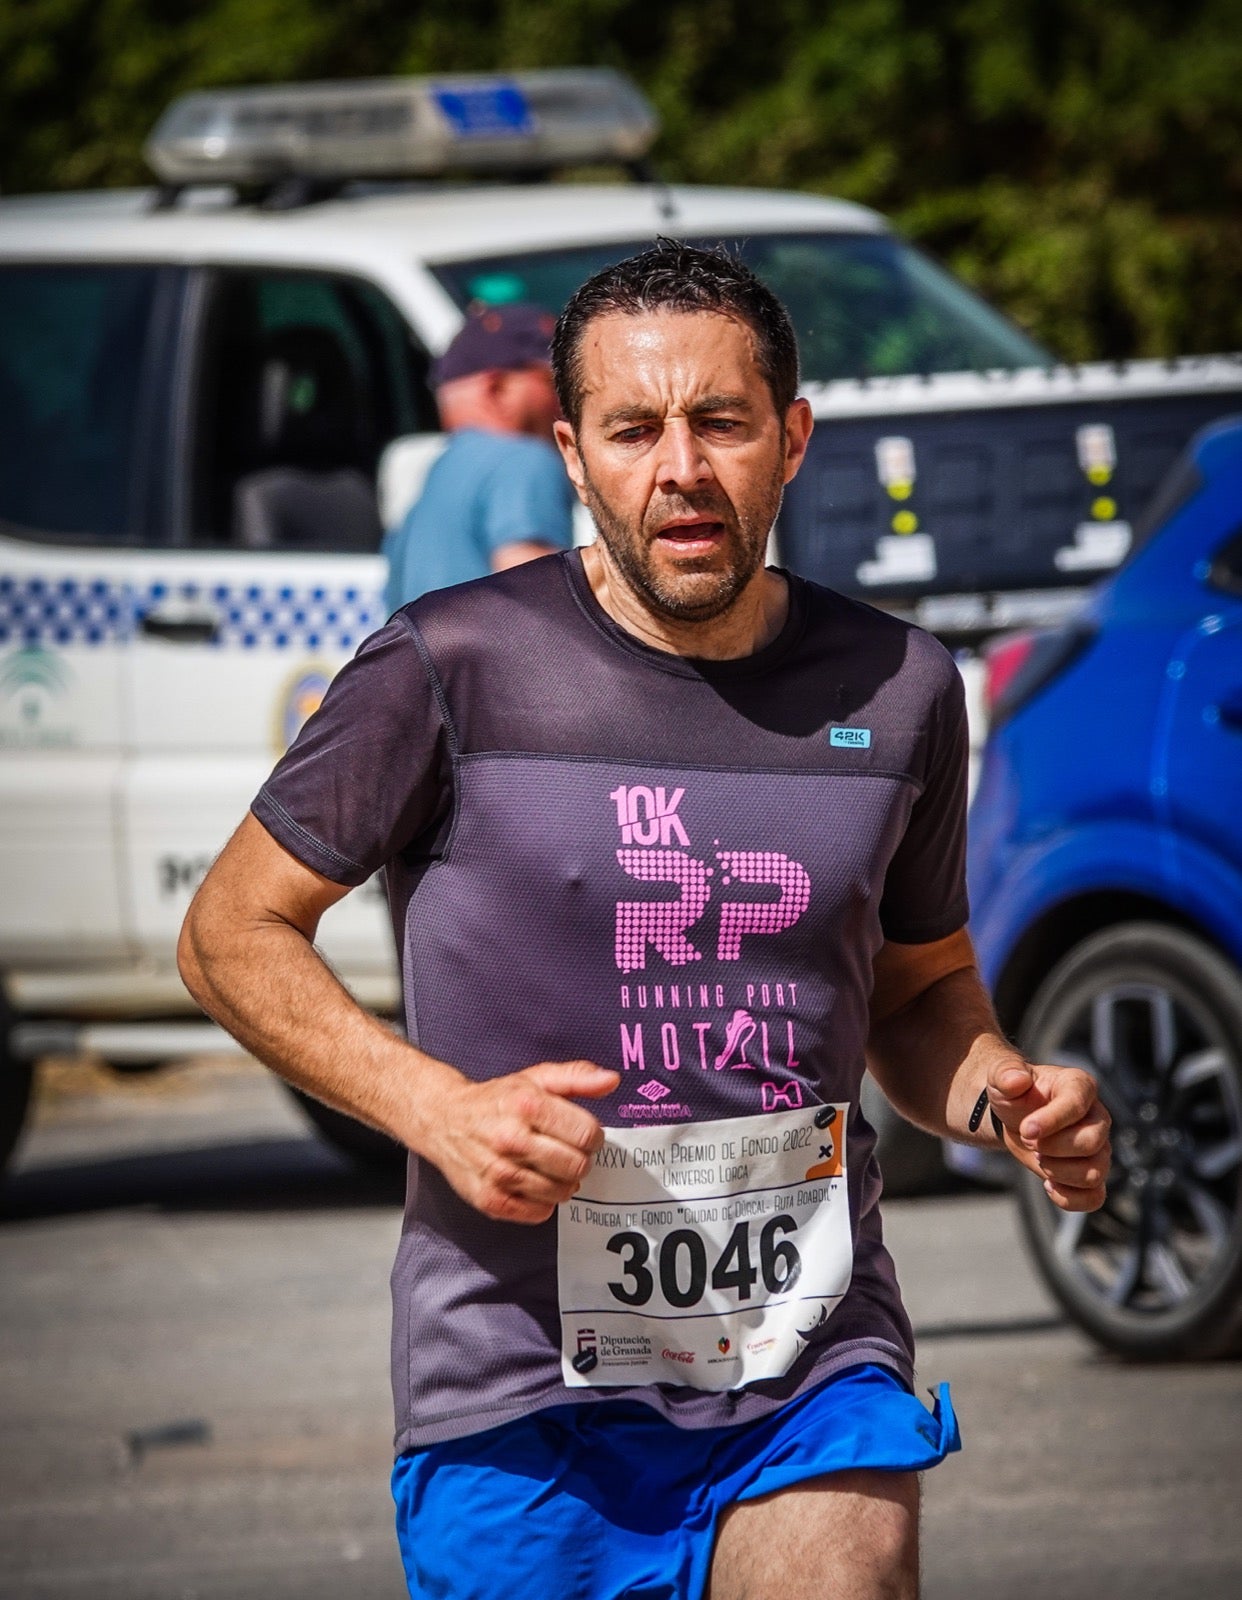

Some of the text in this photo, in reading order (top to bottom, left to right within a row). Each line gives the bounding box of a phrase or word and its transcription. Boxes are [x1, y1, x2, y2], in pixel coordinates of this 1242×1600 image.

[834, 731, 865, 741] 42K
[610, 785, 691, 846] 10K
[621, 983, 797, 1008] RUNNING PORT
[633, 1147, 666, 1169] GRAN
[671, 1142, 716, 1164] PREMIO
[722, 1142, 736, 1160] DE
[742, 1136, 778, 1158] FONDO
[783, 1125, 813, 1152] 2022
[663, 1164, 749, 1188] UNIVERSO LORCA
[570, 1205, 581, 1223] XL
[585, 1207, 621, 1228] PRUEBA
[626, 1213, 637, 1228] DE
[641, 1209, 673, 1226] FONDO
[722, 1206, 732, 1220] DE
[774, 1194, 794, 1211] RUTA
[606, 1214, 801, 1308] 3046
[600, 1335, 651, 1347] Diputación
[600, 1345, 652, 1356] de Granada
